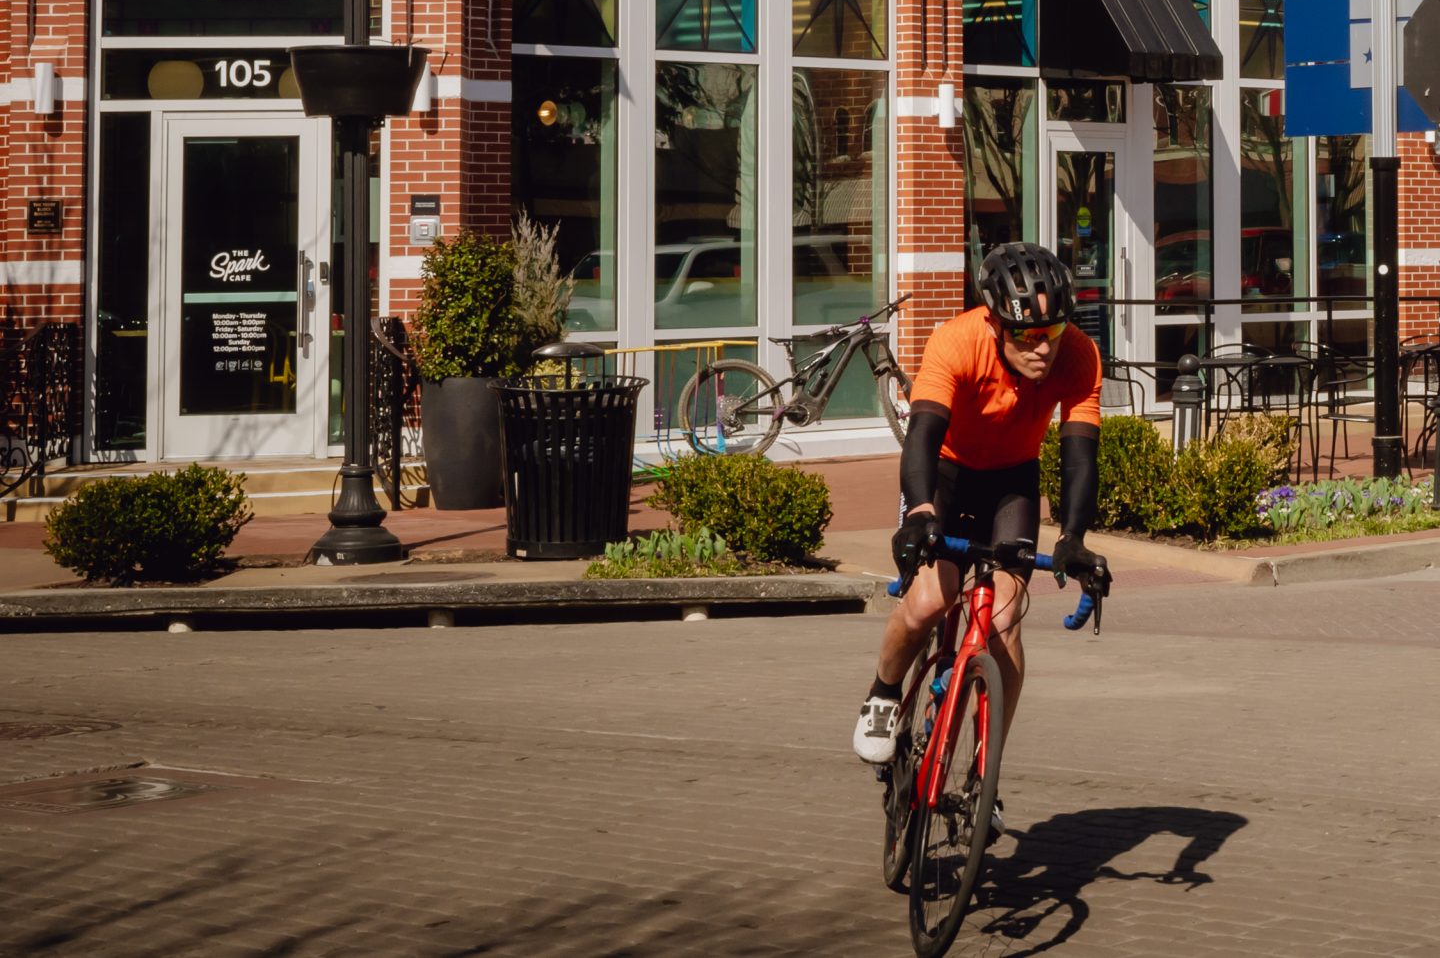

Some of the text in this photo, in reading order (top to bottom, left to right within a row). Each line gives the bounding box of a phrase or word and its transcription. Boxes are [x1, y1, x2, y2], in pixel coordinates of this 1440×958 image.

[215, 59, 272, 87] 105
[209, 249, 271, 282] Spark
[229, 274, 252, 282] CAFE
